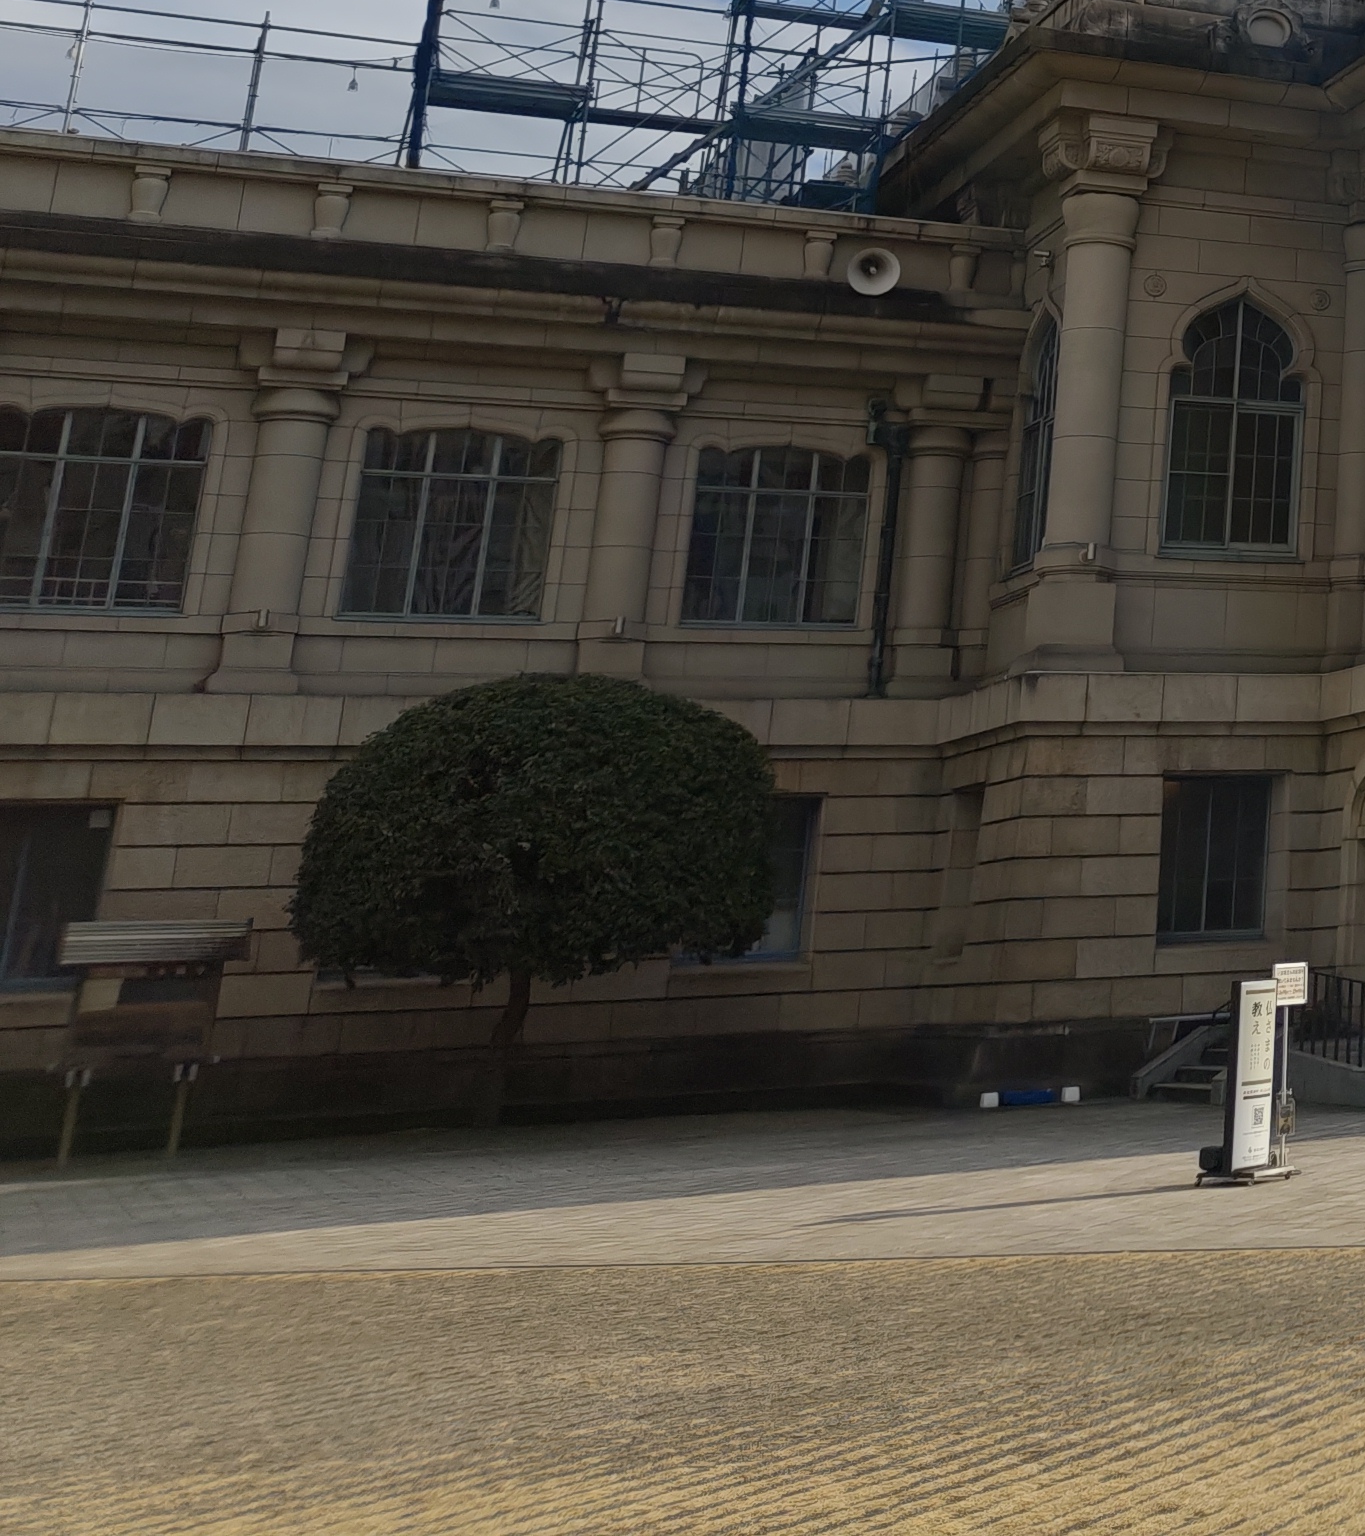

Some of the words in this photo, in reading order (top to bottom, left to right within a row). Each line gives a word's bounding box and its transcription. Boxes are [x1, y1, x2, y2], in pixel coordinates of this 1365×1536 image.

[1251, 1001, 1263, 1036] 教え
[1263, 1000, 1274, 1070] 仏さまの
